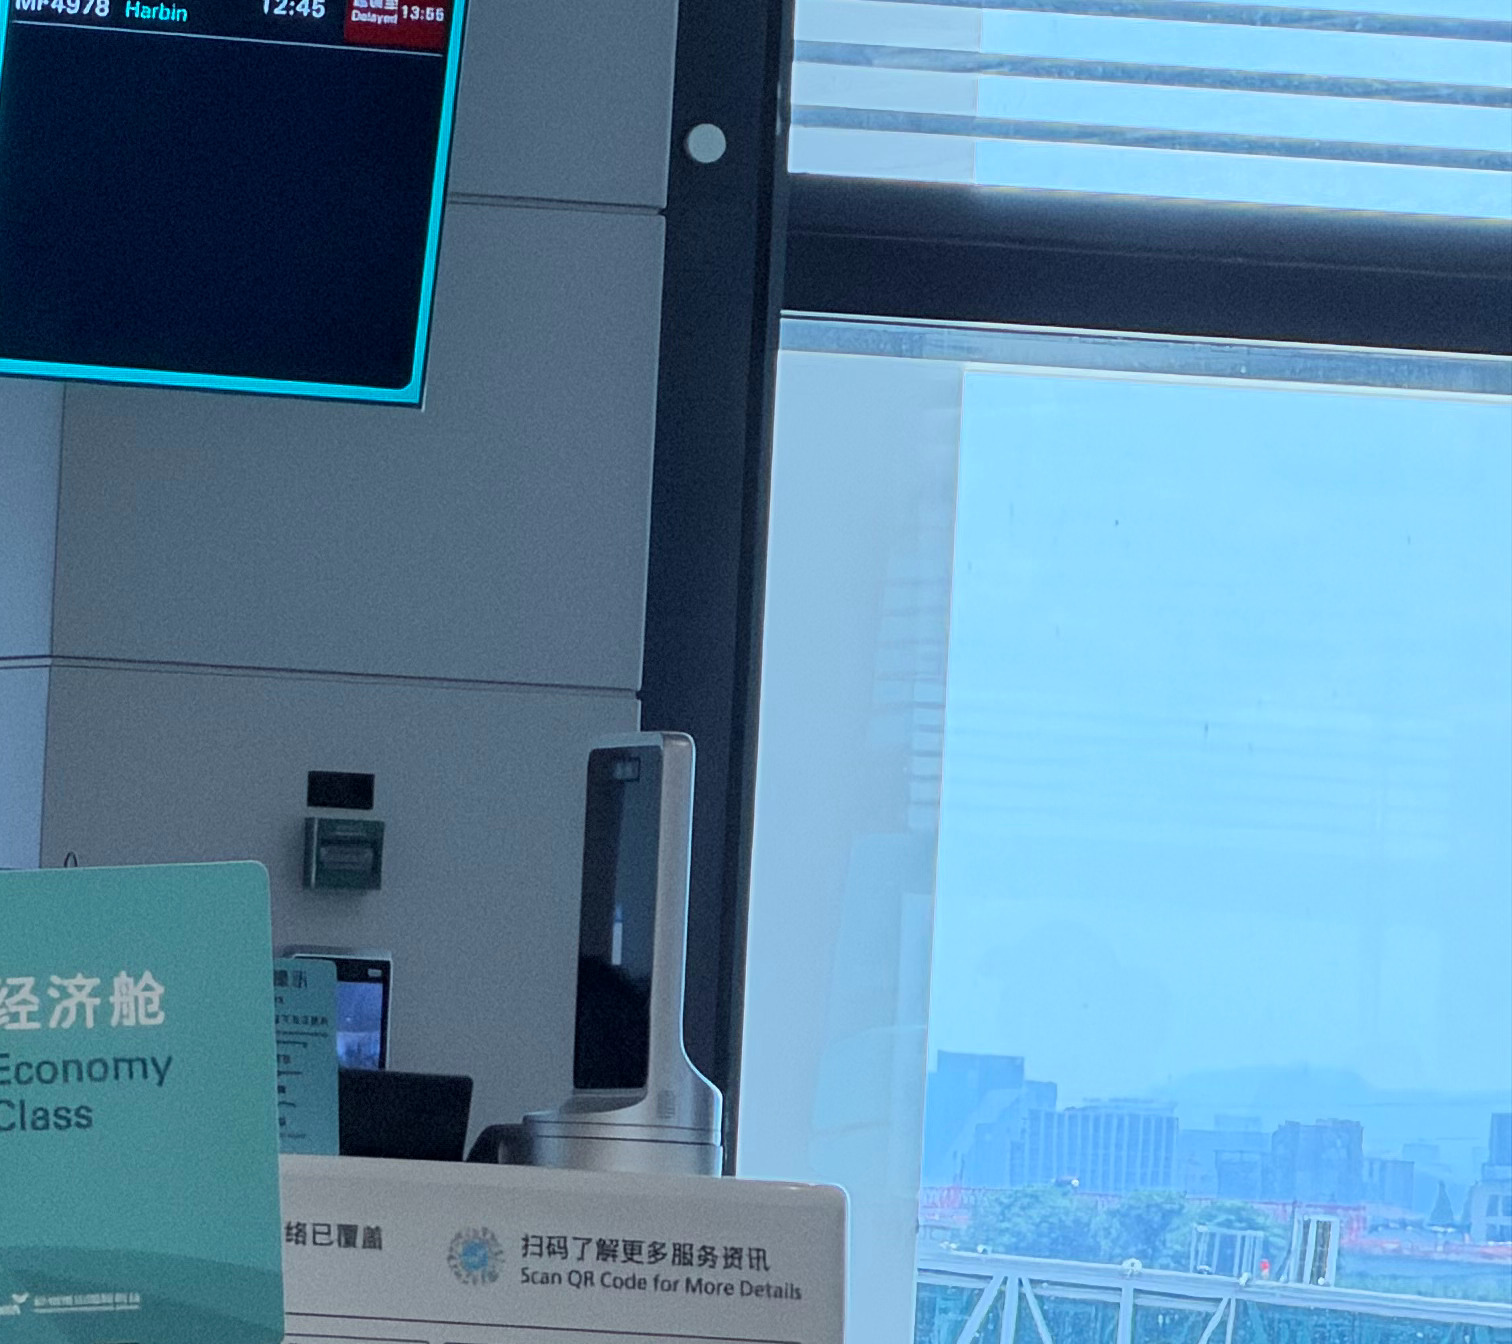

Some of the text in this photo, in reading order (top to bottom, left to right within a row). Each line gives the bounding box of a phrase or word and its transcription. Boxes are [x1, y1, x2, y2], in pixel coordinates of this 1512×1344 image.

[125, 0, 188, 23] Harbin
[520, 1234, 772, 1274] 扫码了解更多服务资讯
[520, 1265, 803, 1302] Scan QR Code for More Details
